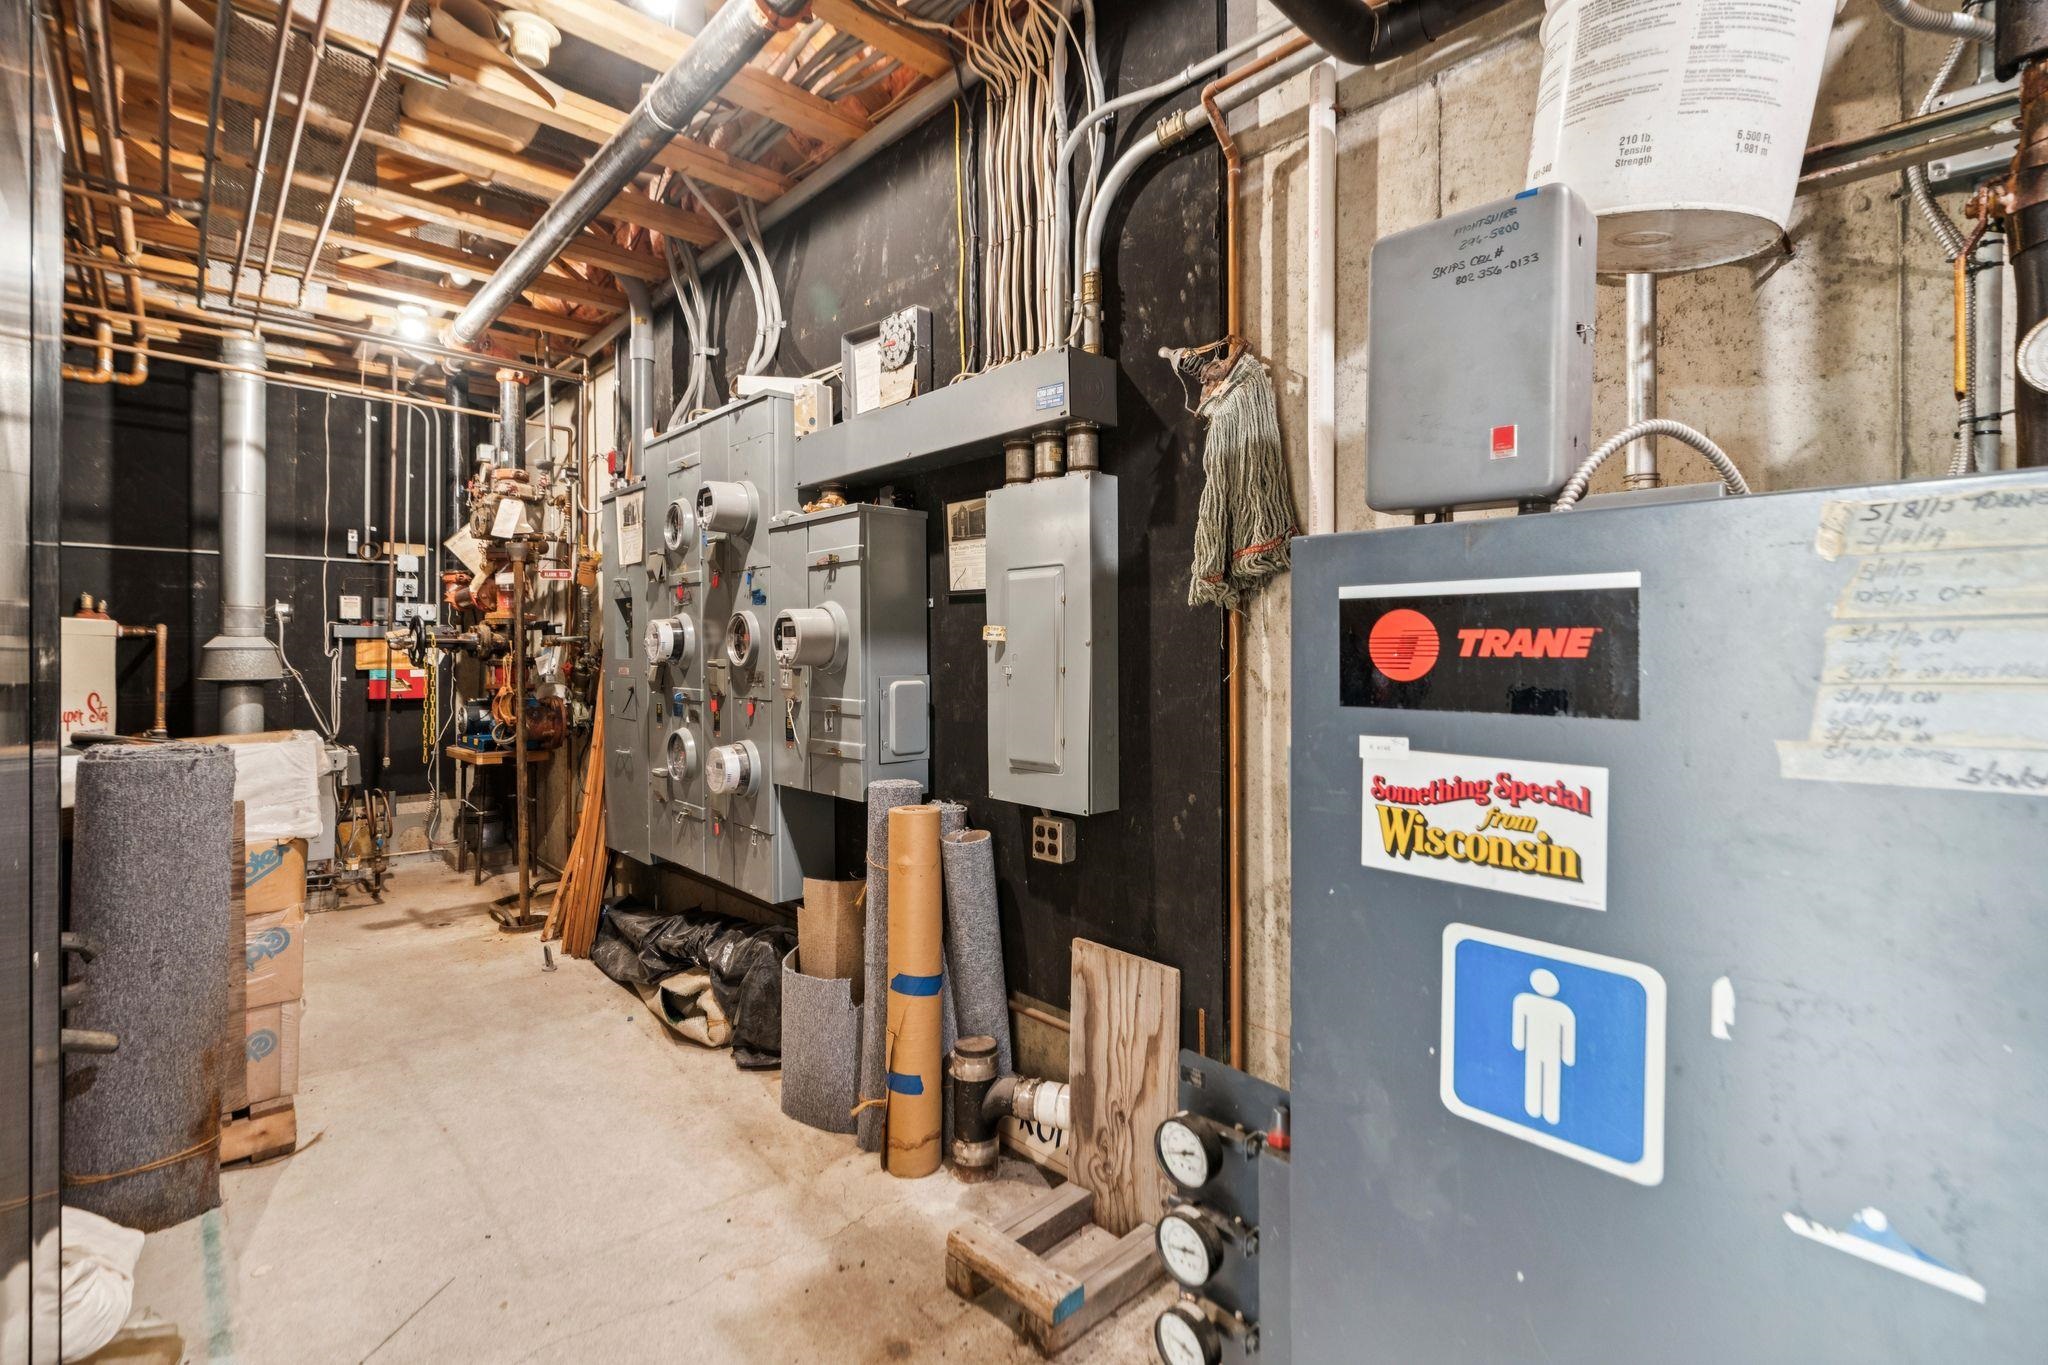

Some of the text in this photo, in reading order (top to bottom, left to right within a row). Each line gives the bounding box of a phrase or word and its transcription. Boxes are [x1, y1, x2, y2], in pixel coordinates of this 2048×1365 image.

[1619, 133, 1654, 146] 210 lb.
[1619, 144, 1652, 157] Tensile
[1614, 155, 1653, 169] Strength
[1431, 260, 1466, 279] SKIPS
[1455, 252, 1540, 286] 802 356-0133
[1457, 627, 1595, 658] TRANE
[1370, 772, 1593, 818] Something Special
[1476, 806, 1539, 834] from
[1375, 804, 1584, 884] Wisconsin
